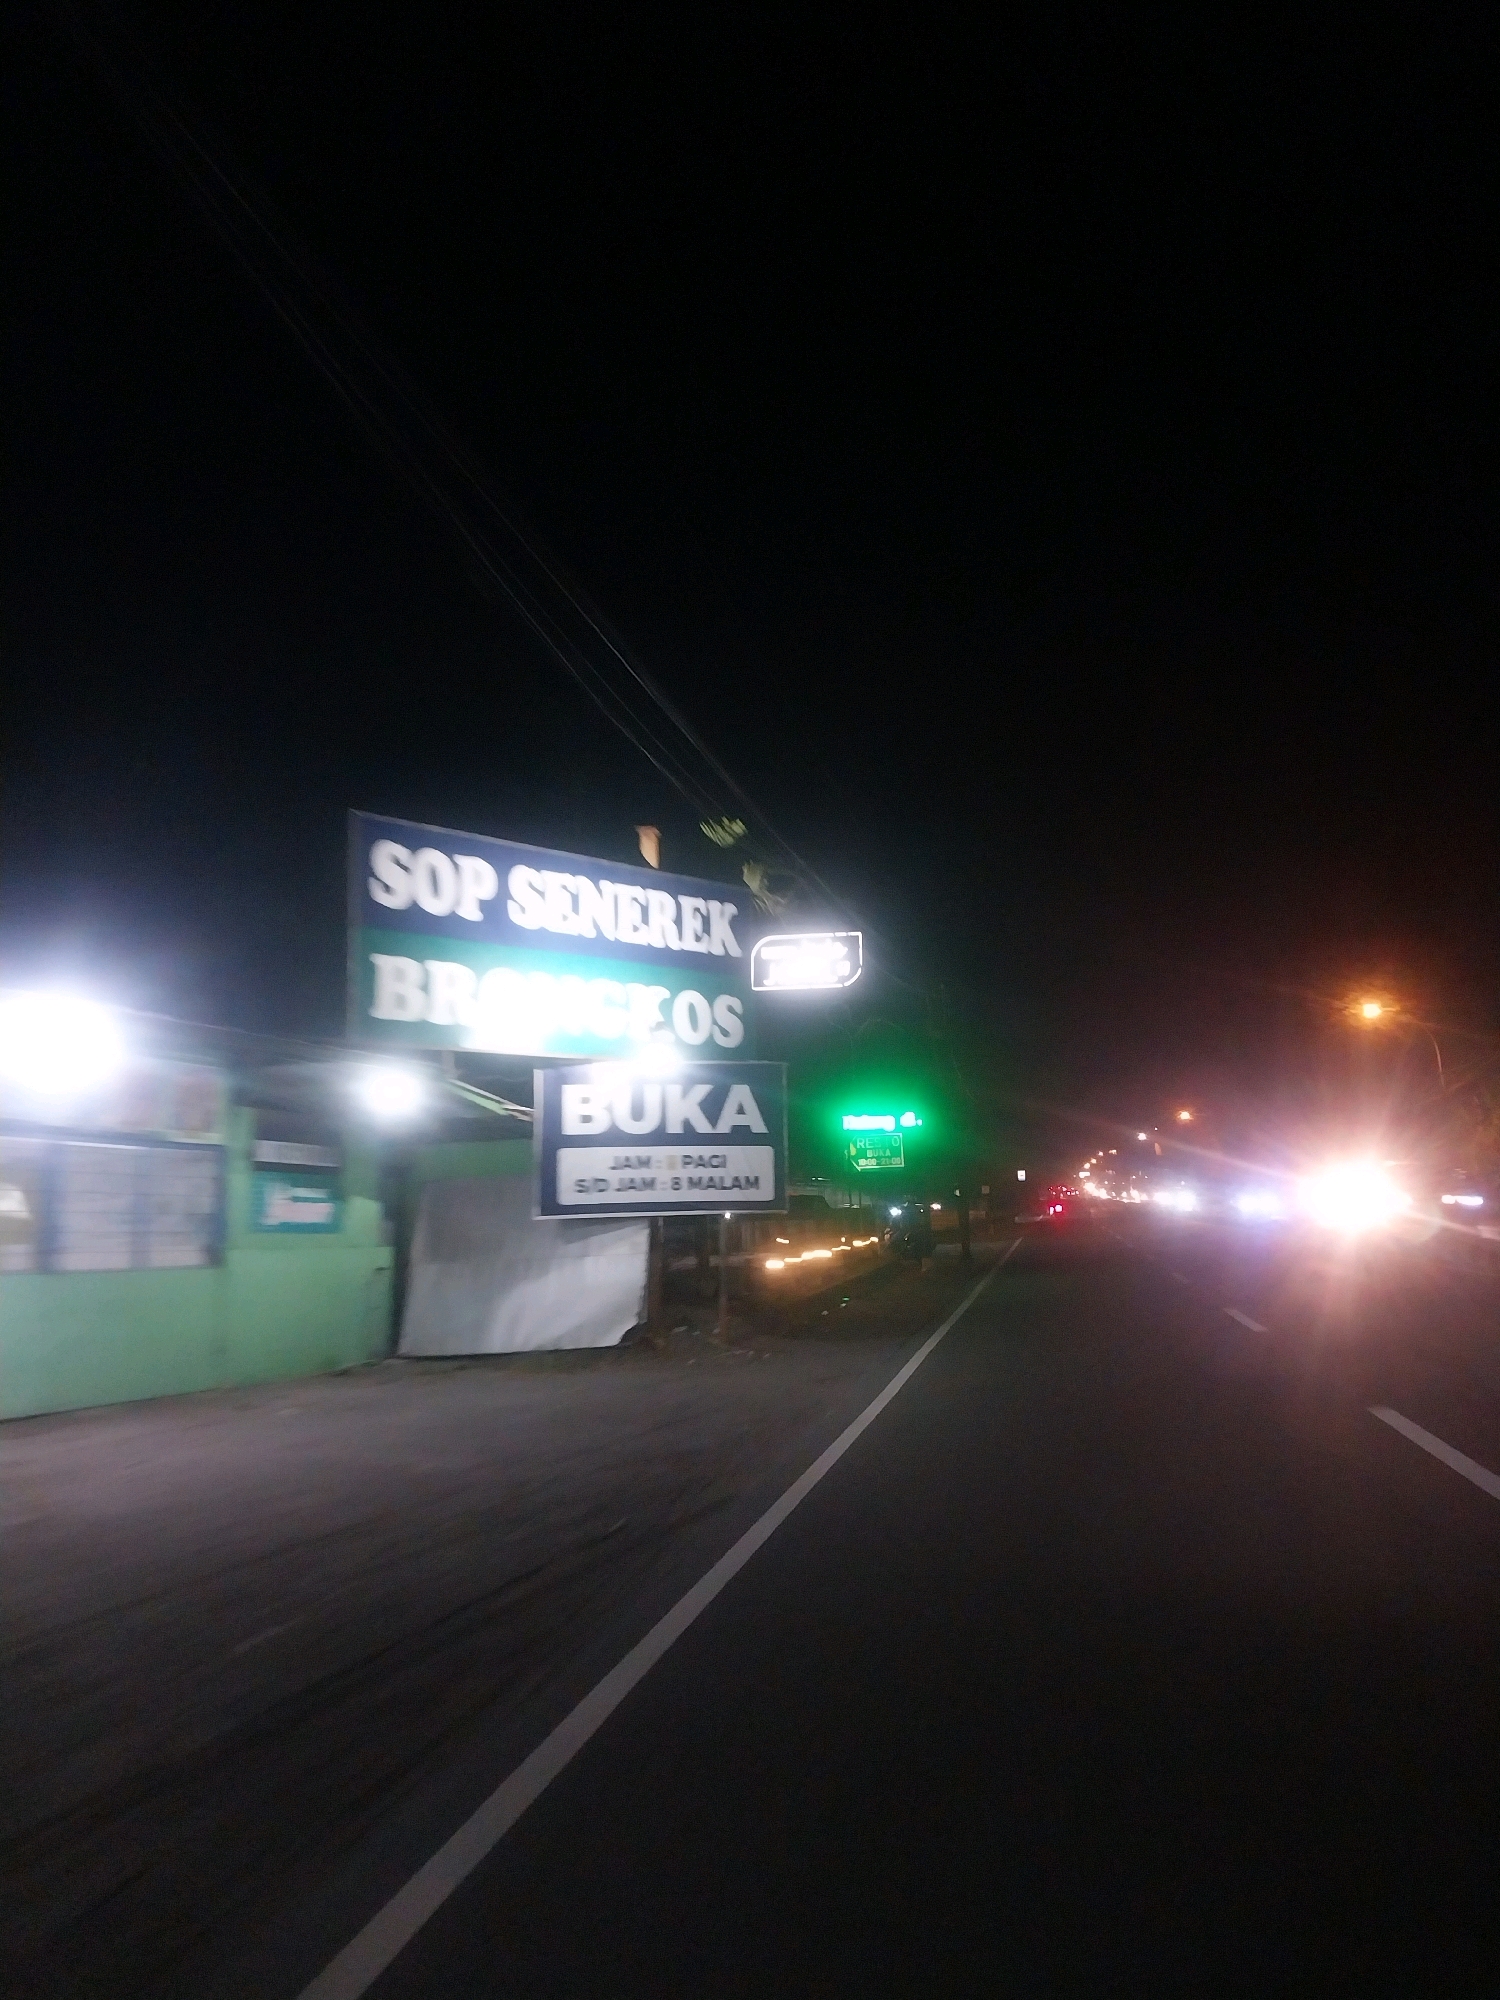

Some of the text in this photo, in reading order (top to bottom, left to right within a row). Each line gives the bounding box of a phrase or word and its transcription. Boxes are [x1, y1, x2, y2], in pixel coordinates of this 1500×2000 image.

[369, 838, 743, 959] SOP SENEREK
[370, 953, 744, 1049] BRGKOS
[561, 1082, 768, 1136] BUKA
[608, 1155, 652, 1171] JAM
[681, 1154, 728, 1169] PAGI
[614, 1176, 657, 1192] JAM
[687, 1176, 760, 1191] MALAM
